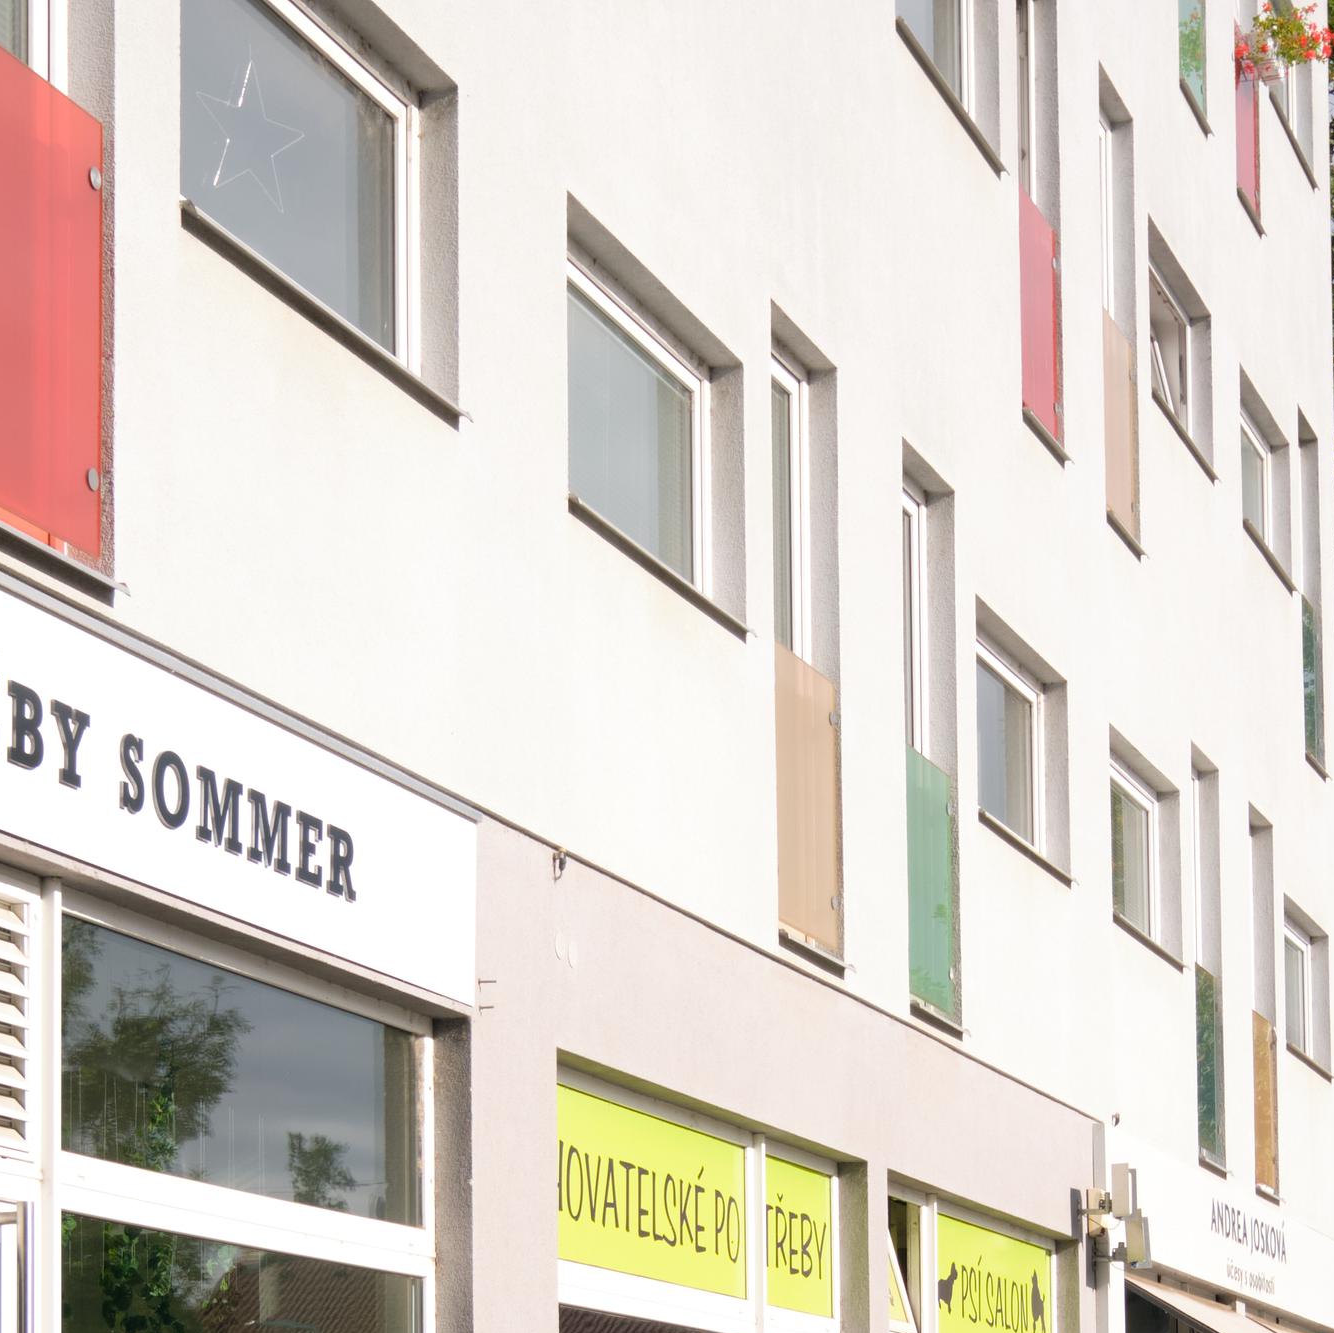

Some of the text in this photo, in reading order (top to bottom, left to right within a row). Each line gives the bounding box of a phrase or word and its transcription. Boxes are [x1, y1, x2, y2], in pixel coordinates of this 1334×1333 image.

[119, 732, 357, 903] SOMMER
[1210, 1197, 1287, 1265] ANDREA JOSKOVÁ
[961, 1255, 982, 1324] PSÍ
